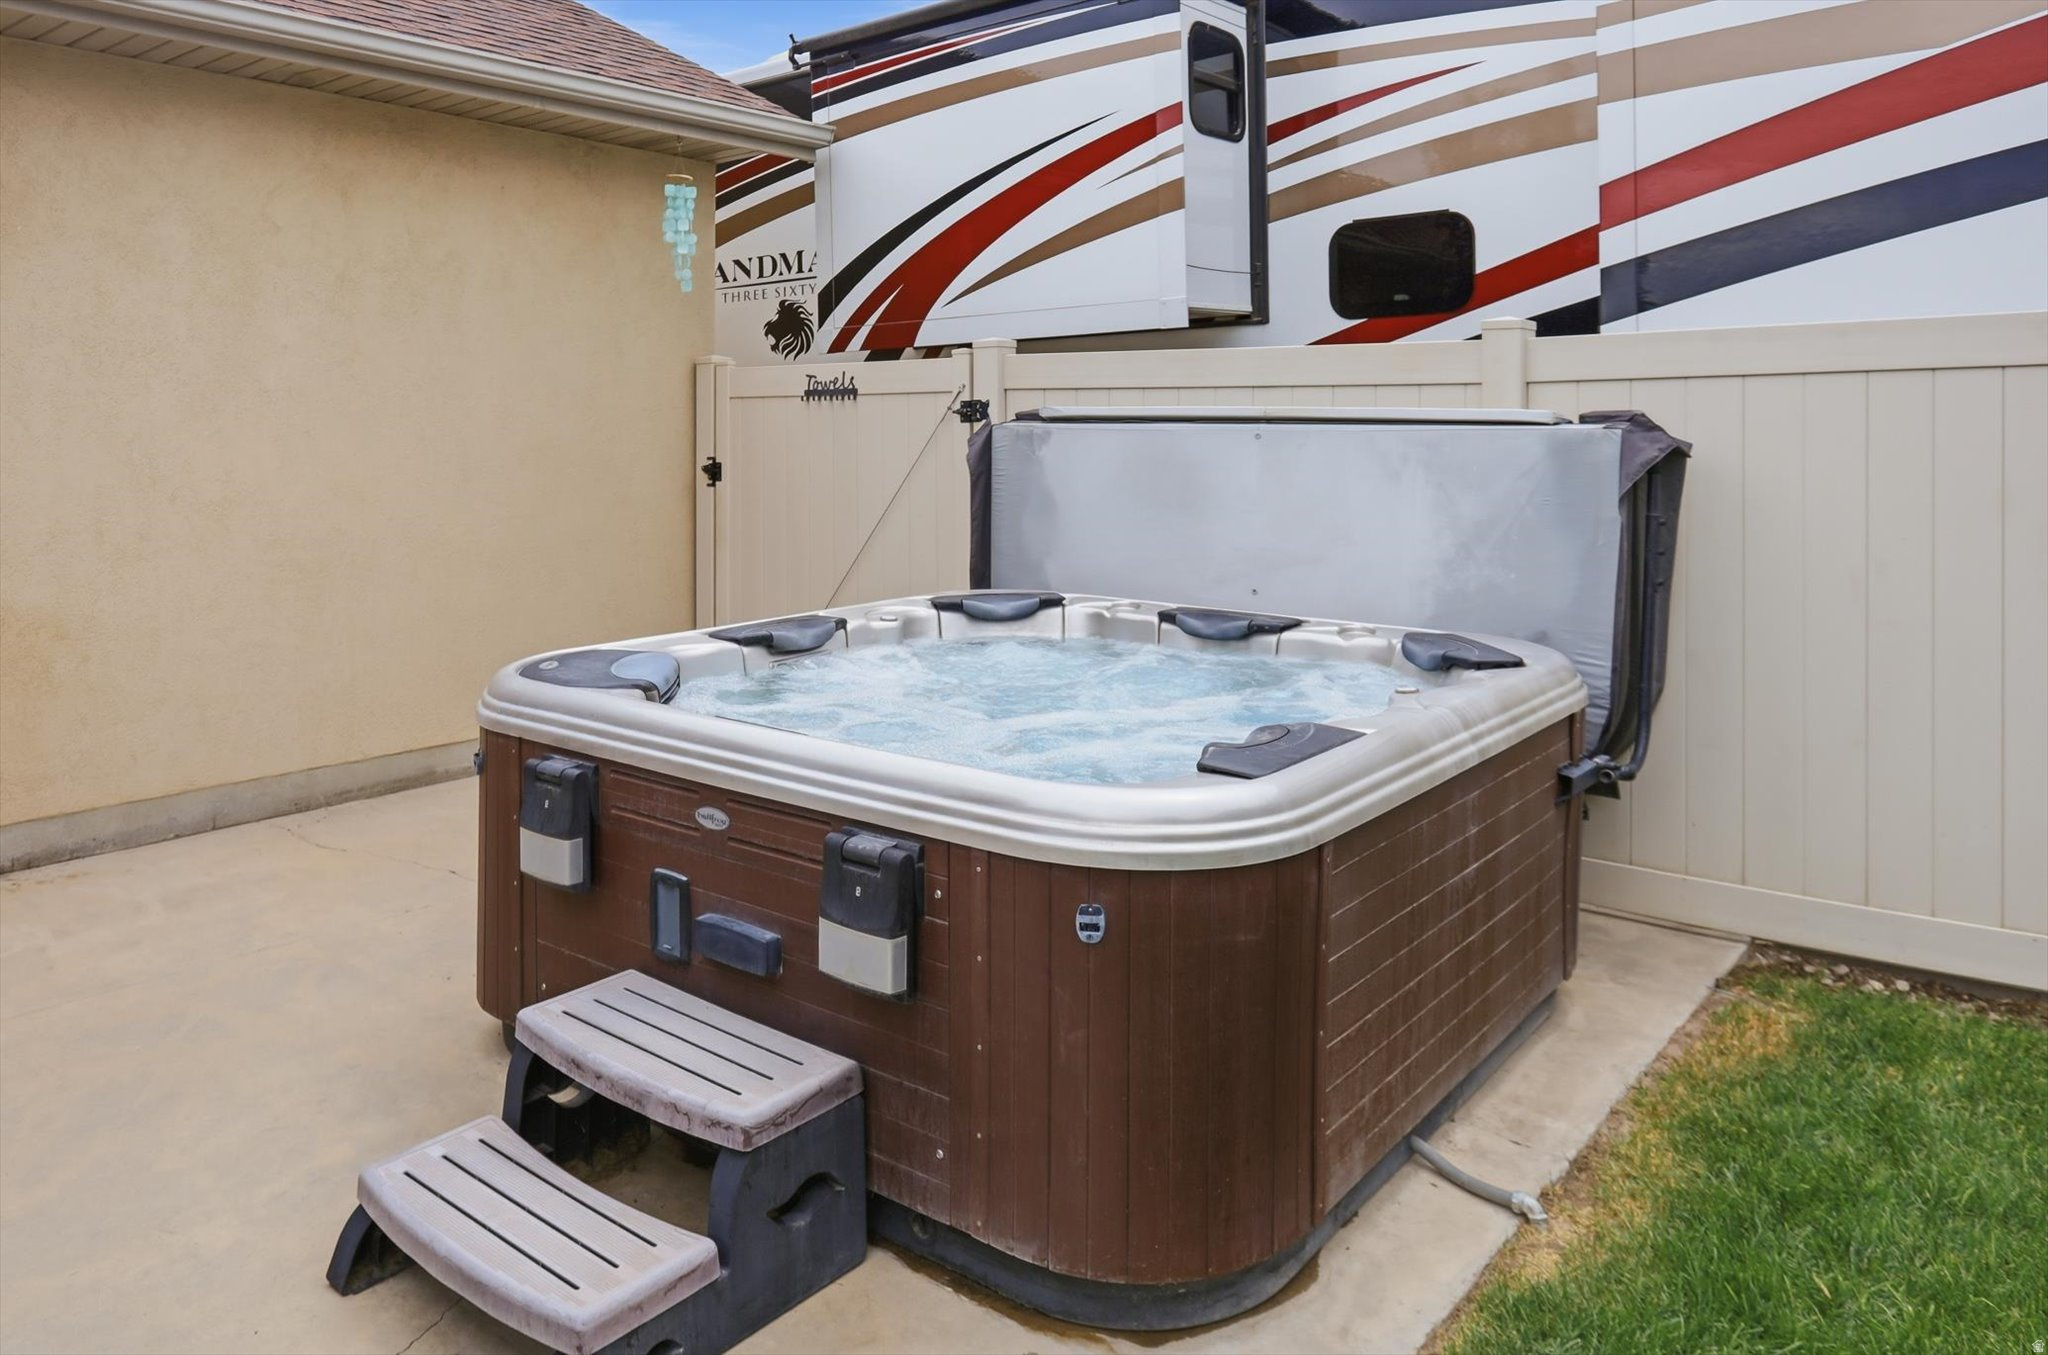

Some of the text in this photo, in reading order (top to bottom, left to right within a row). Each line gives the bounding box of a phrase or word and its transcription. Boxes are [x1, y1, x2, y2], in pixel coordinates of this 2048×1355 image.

[722, 283, 817, 303] THREE SIXTY
[805, 370, 856, 391] Towels
